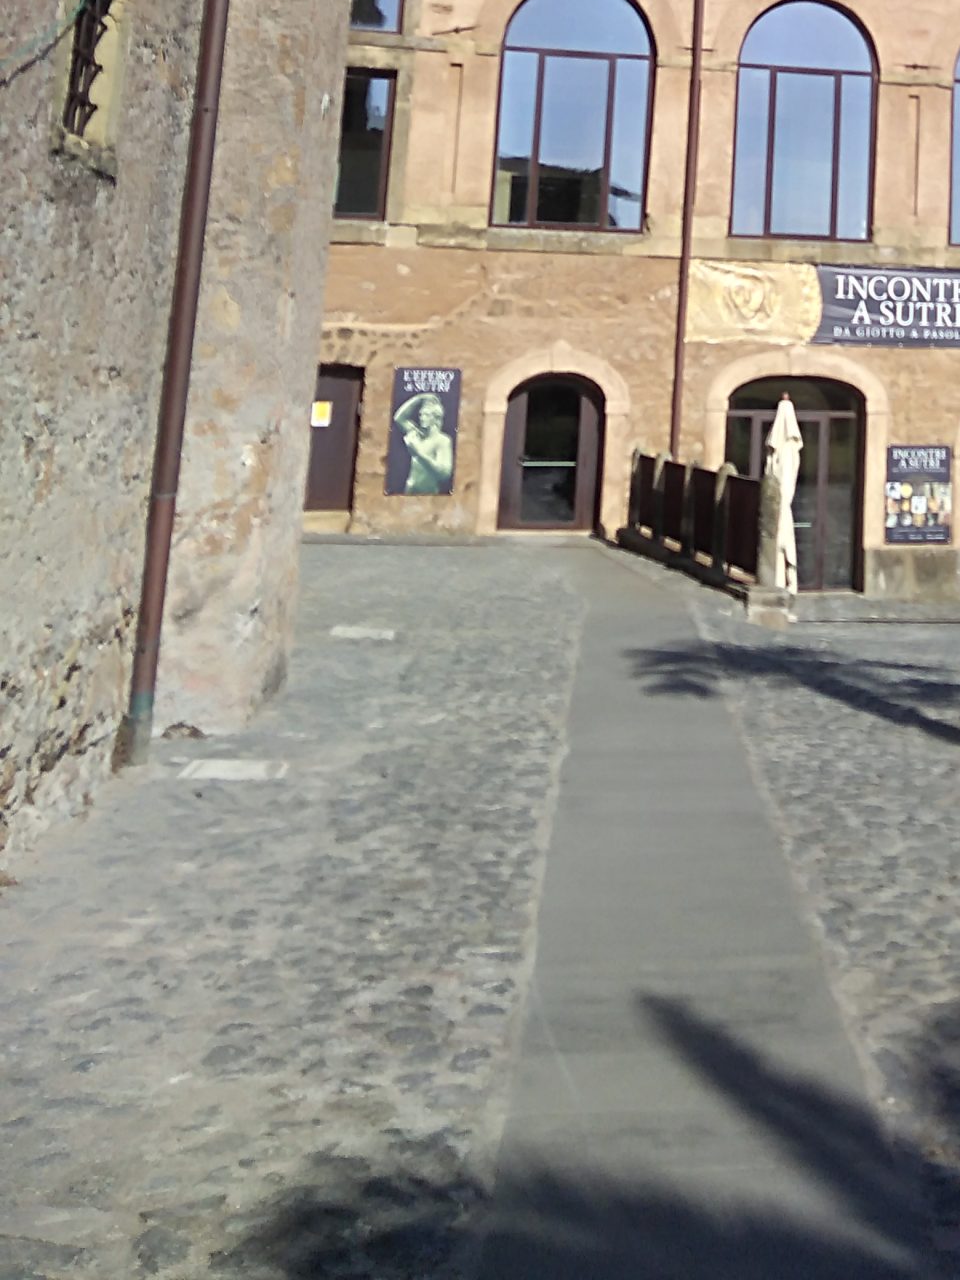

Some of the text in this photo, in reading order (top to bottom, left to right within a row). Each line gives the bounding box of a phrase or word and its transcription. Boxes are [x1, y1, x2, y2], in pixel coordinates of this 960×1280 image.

[851, 300, 872, 325] A
[833, 326, 851, 337] DA
[855, 326, 905, 339] GIOTTO
[909, 328, 919, 339] A
